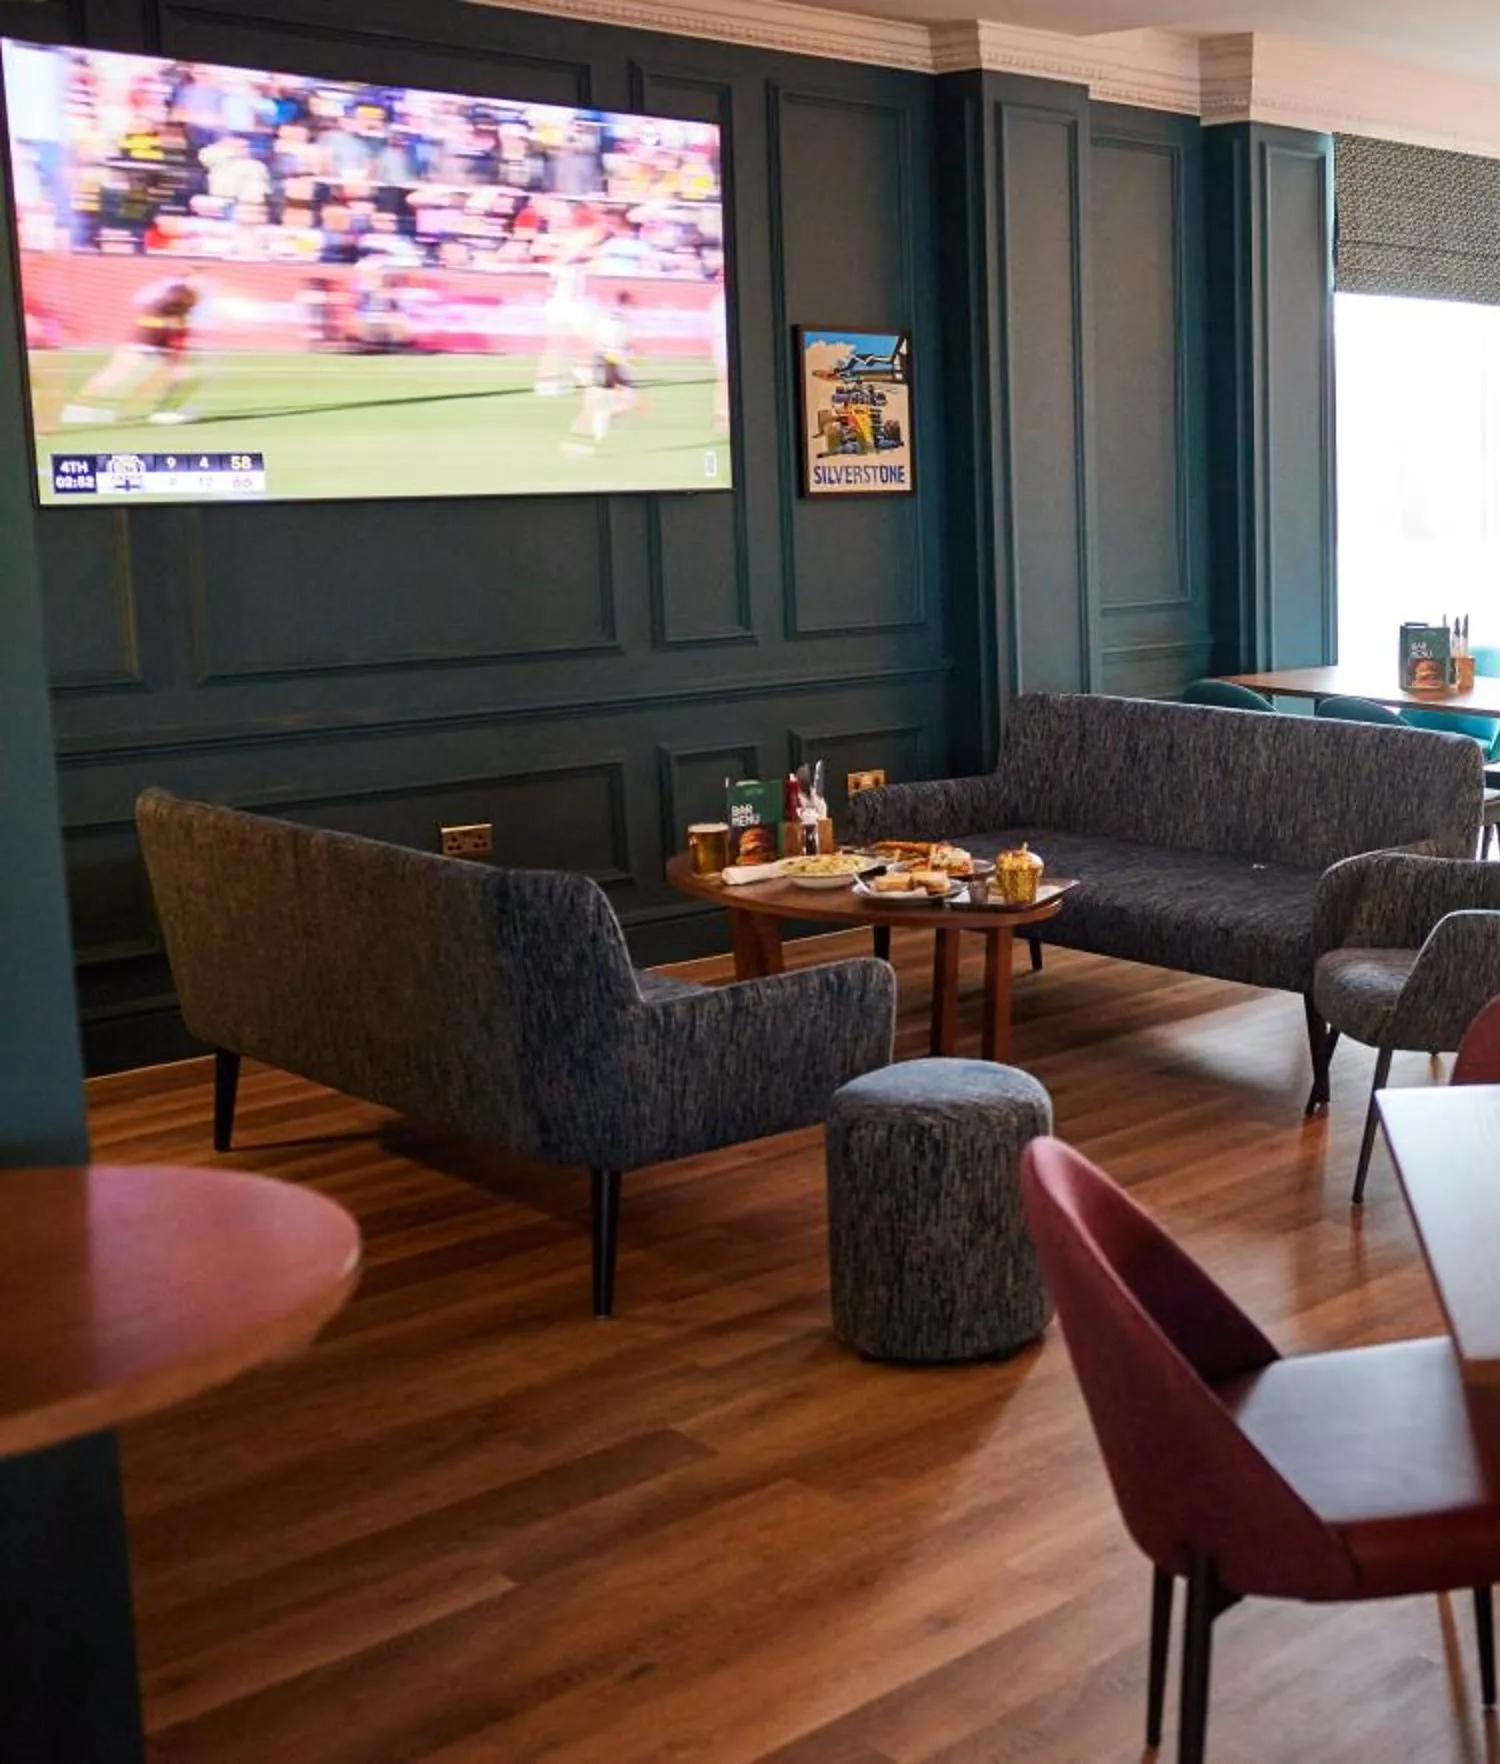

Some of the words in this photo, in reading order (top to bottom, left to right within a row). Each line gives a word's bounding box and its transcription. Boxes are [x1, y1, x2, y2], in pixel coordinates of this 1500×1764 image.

[60, 461, 89, 474] 4TH
[166, 456, 176, 469] 9
[200, 456, 209, 469] 4
[813, 465, 905, 485] SILVERSTONE
[731, 803, 753, 817] BAR
[731, 815, 761, 827] MENU
